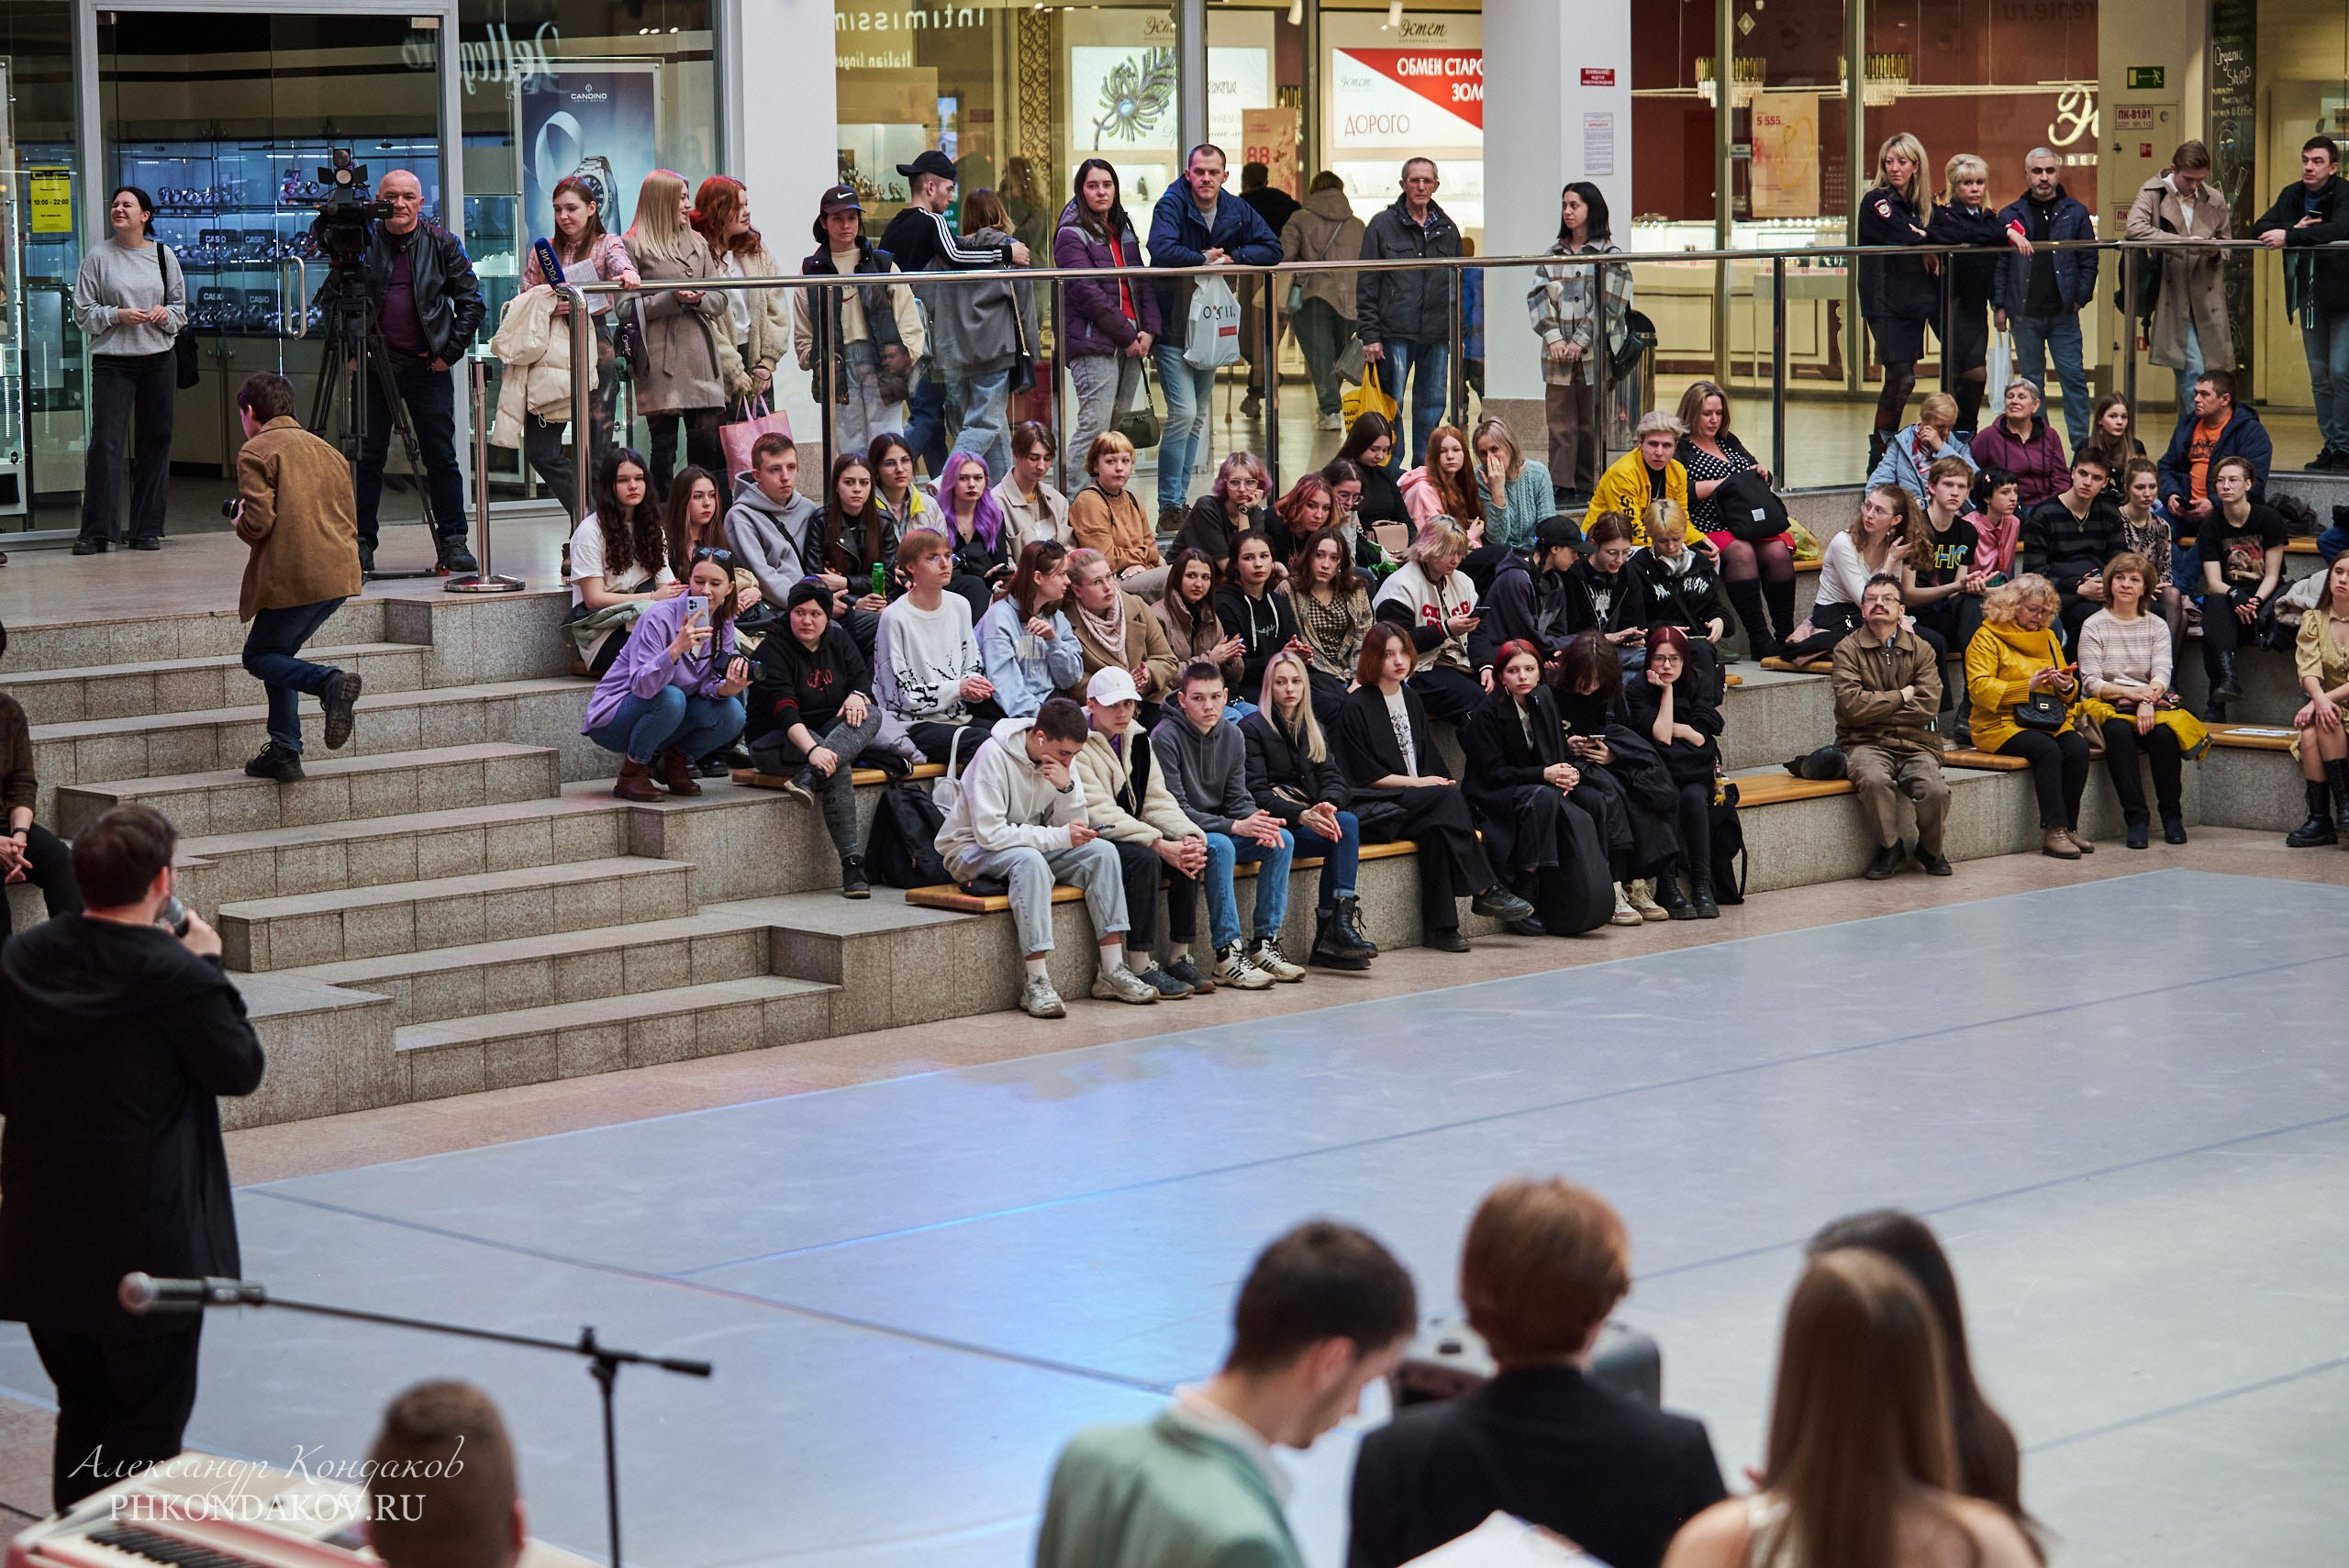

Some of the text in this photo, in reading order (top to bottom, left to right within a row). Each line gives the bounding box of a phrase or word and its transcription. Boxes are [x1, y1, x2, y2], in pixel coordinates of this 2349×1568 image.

[1397, 57, 1442, 76] ОБМЕН
[1344, 114, 1410, 138] ДОРОГО
[205, 235, 227, 243] CASO
[540, 249, 559, 282] РОССИЯ
